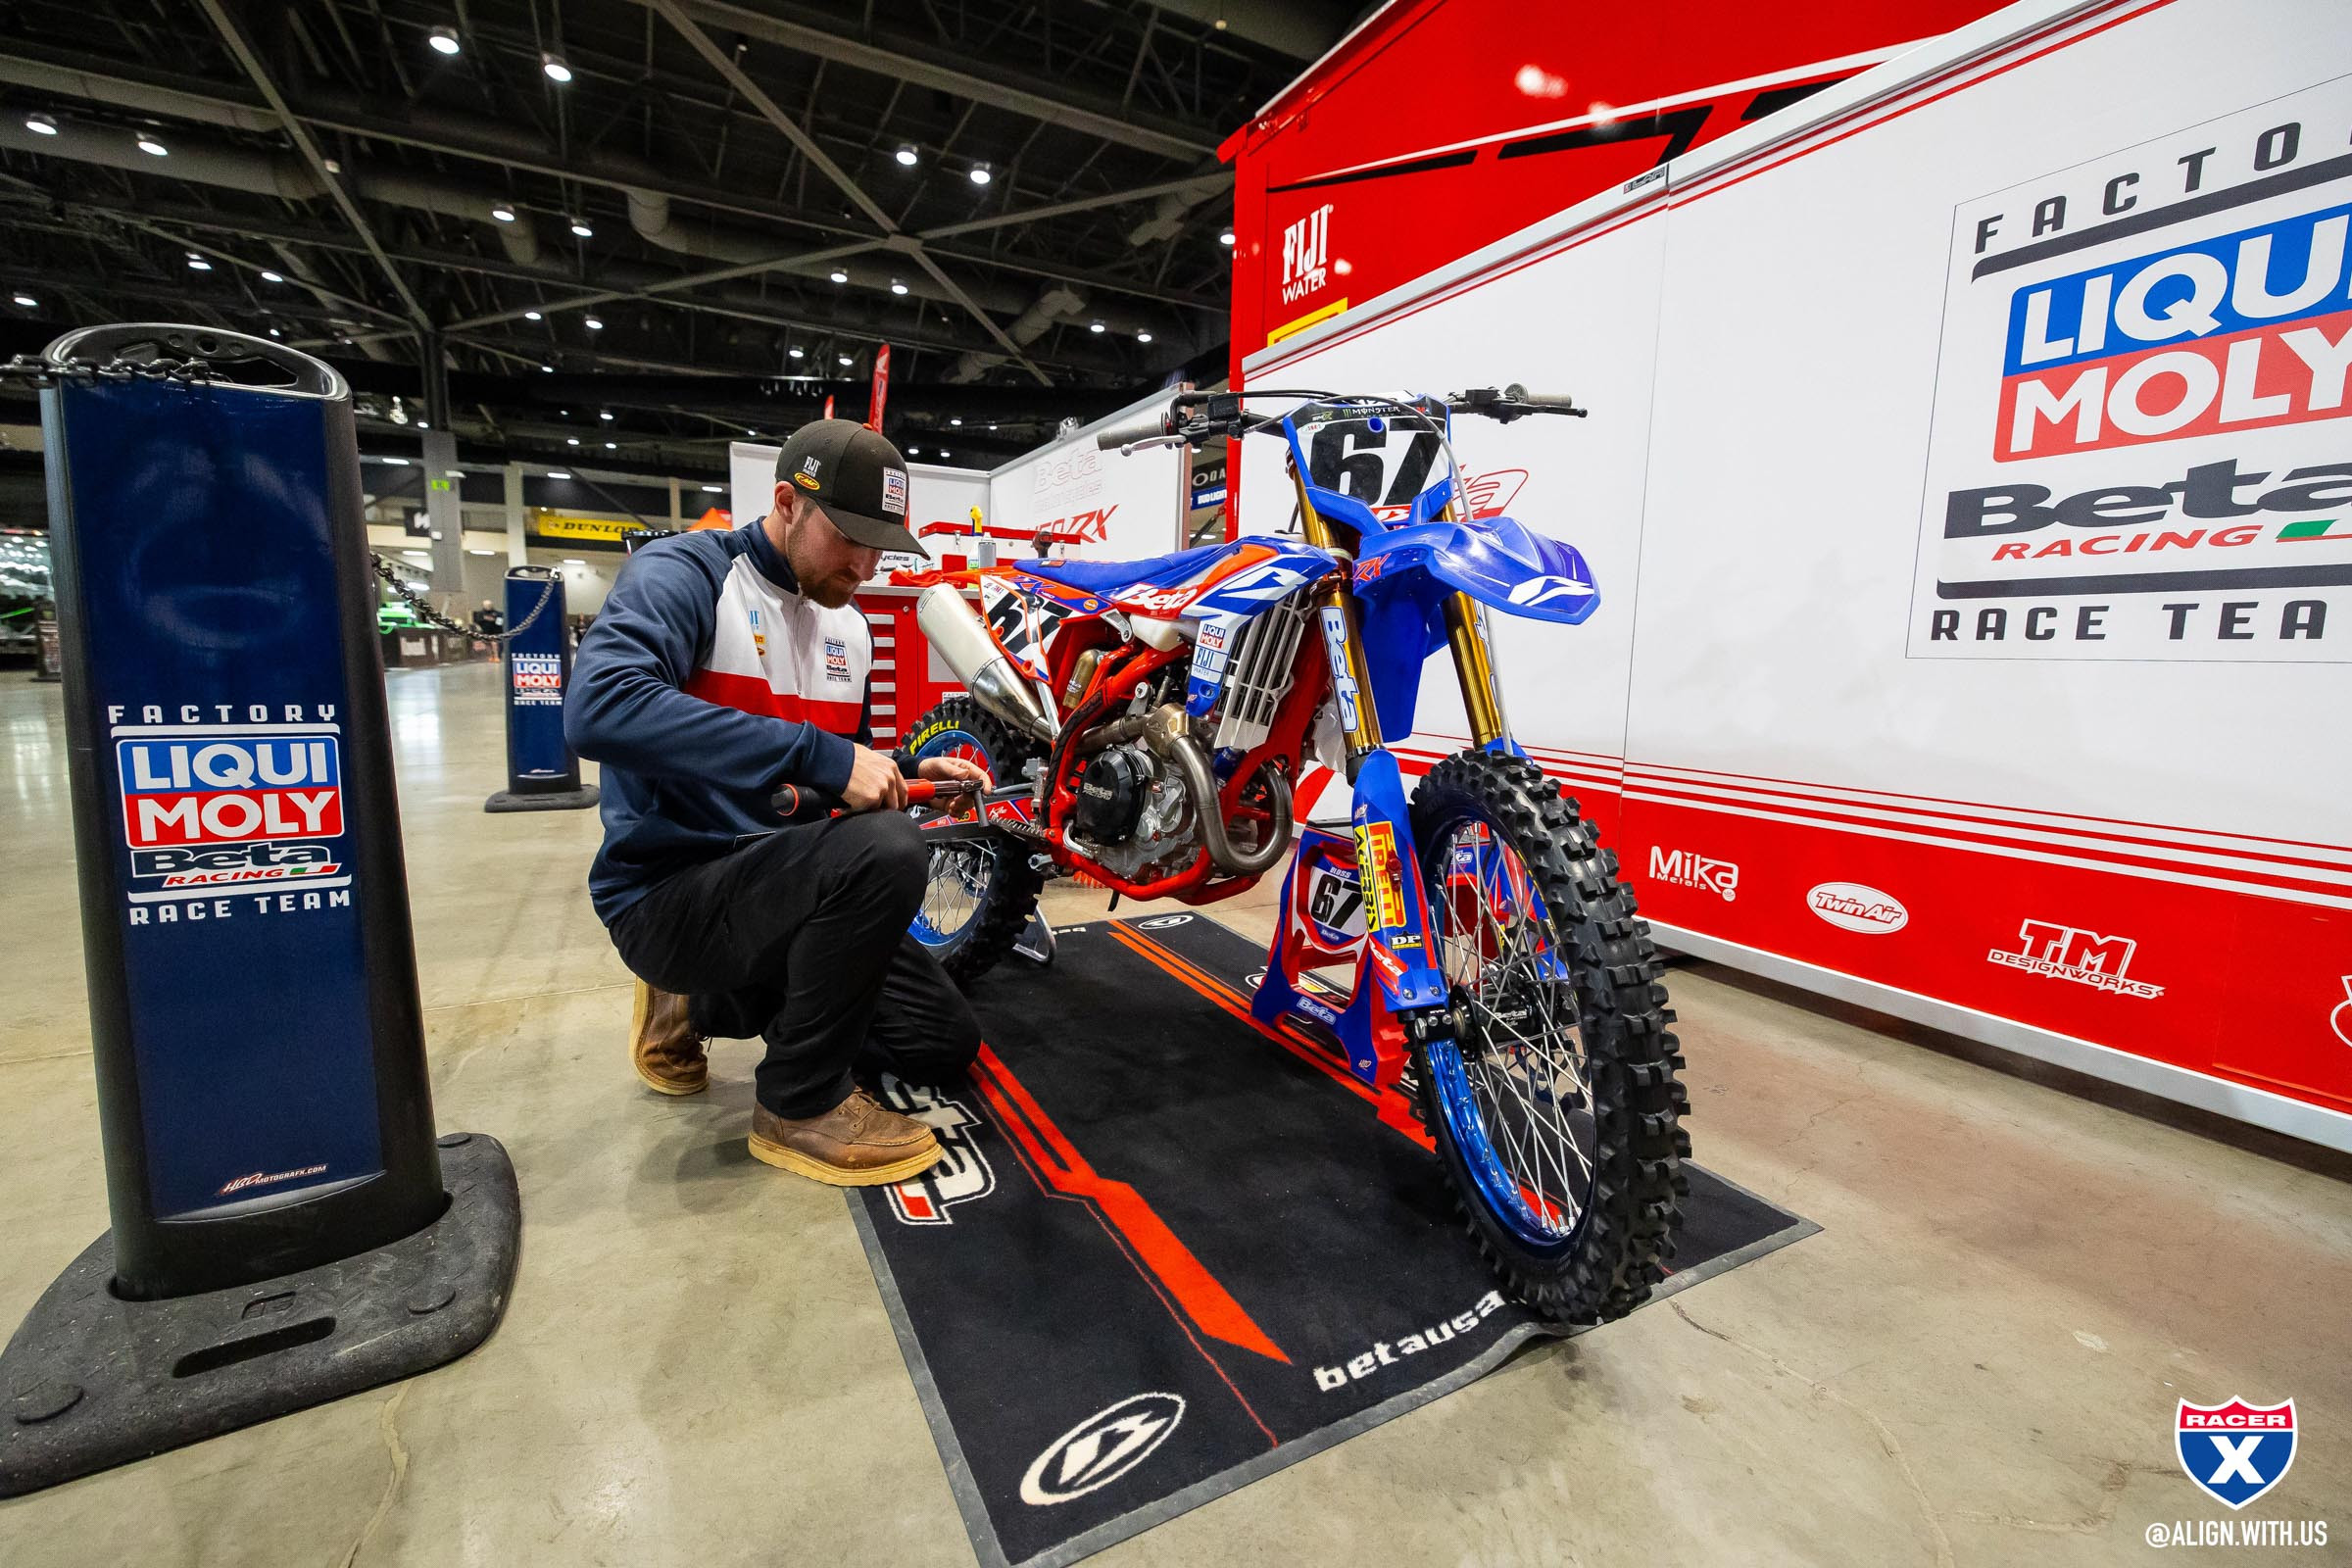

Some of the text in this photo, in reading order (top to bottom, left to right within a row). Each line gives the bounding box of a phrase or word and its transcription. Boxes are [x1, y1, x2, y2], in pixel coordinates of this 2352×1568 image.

[1976, 122, 2352, 254] FACTO
[1283, 204, 1329, 285] FIJI
[1283, 267, 1327, 305] WATER
[2020, 214, 2352, 366] LIQU
[2010, 326, 2352, 453] MOLY
[804, 456, 821, 473] FIJI
[1309, 417, 1446, 507] 67
[1944, 459, 2352, 539] Beta
[1991, 524, 2264, 561] RACING
[1111, 583, 1198, 610] Beta
[1200, 633, 1224, 648] MOLY
[1203, 624, 1226, 637] LIQUI
[1931, 605, 2109, 641] RACE
[516, 662, 558, 674] LIQUI
[827, 655, 847, 665] MOLY
[1196, 648, 1215, 668] FIJI
[1321, 608, 1359, 732] Beta
[516, 674, 561, 687] MOLY
[108, 705, 335, 724] FACTORY
[909, 719, 959, 756] PIRELLI
[132, 743, 328, 790] LIQUI
[137, 791, 336, 842] MOLY
[131, 844, 329, 878] Beta
[166, 868, 284, 886] RACING
[1649, 846, 1739, 894] Mika
[1656, 872, 1707, 890] Metals
[129, 890, 351, 926] RACE TEAM
[1311, 873, 1363, 930] 67
[1816, 892, 1902, 924] Twin Air
[1392, 935, 1422, 945] DP
[2019, 918, 2136, 978] TM
[1990, 951, 2154, 998] DESIGNWORKS
[1297, 997, 1337, 1025] Beta
